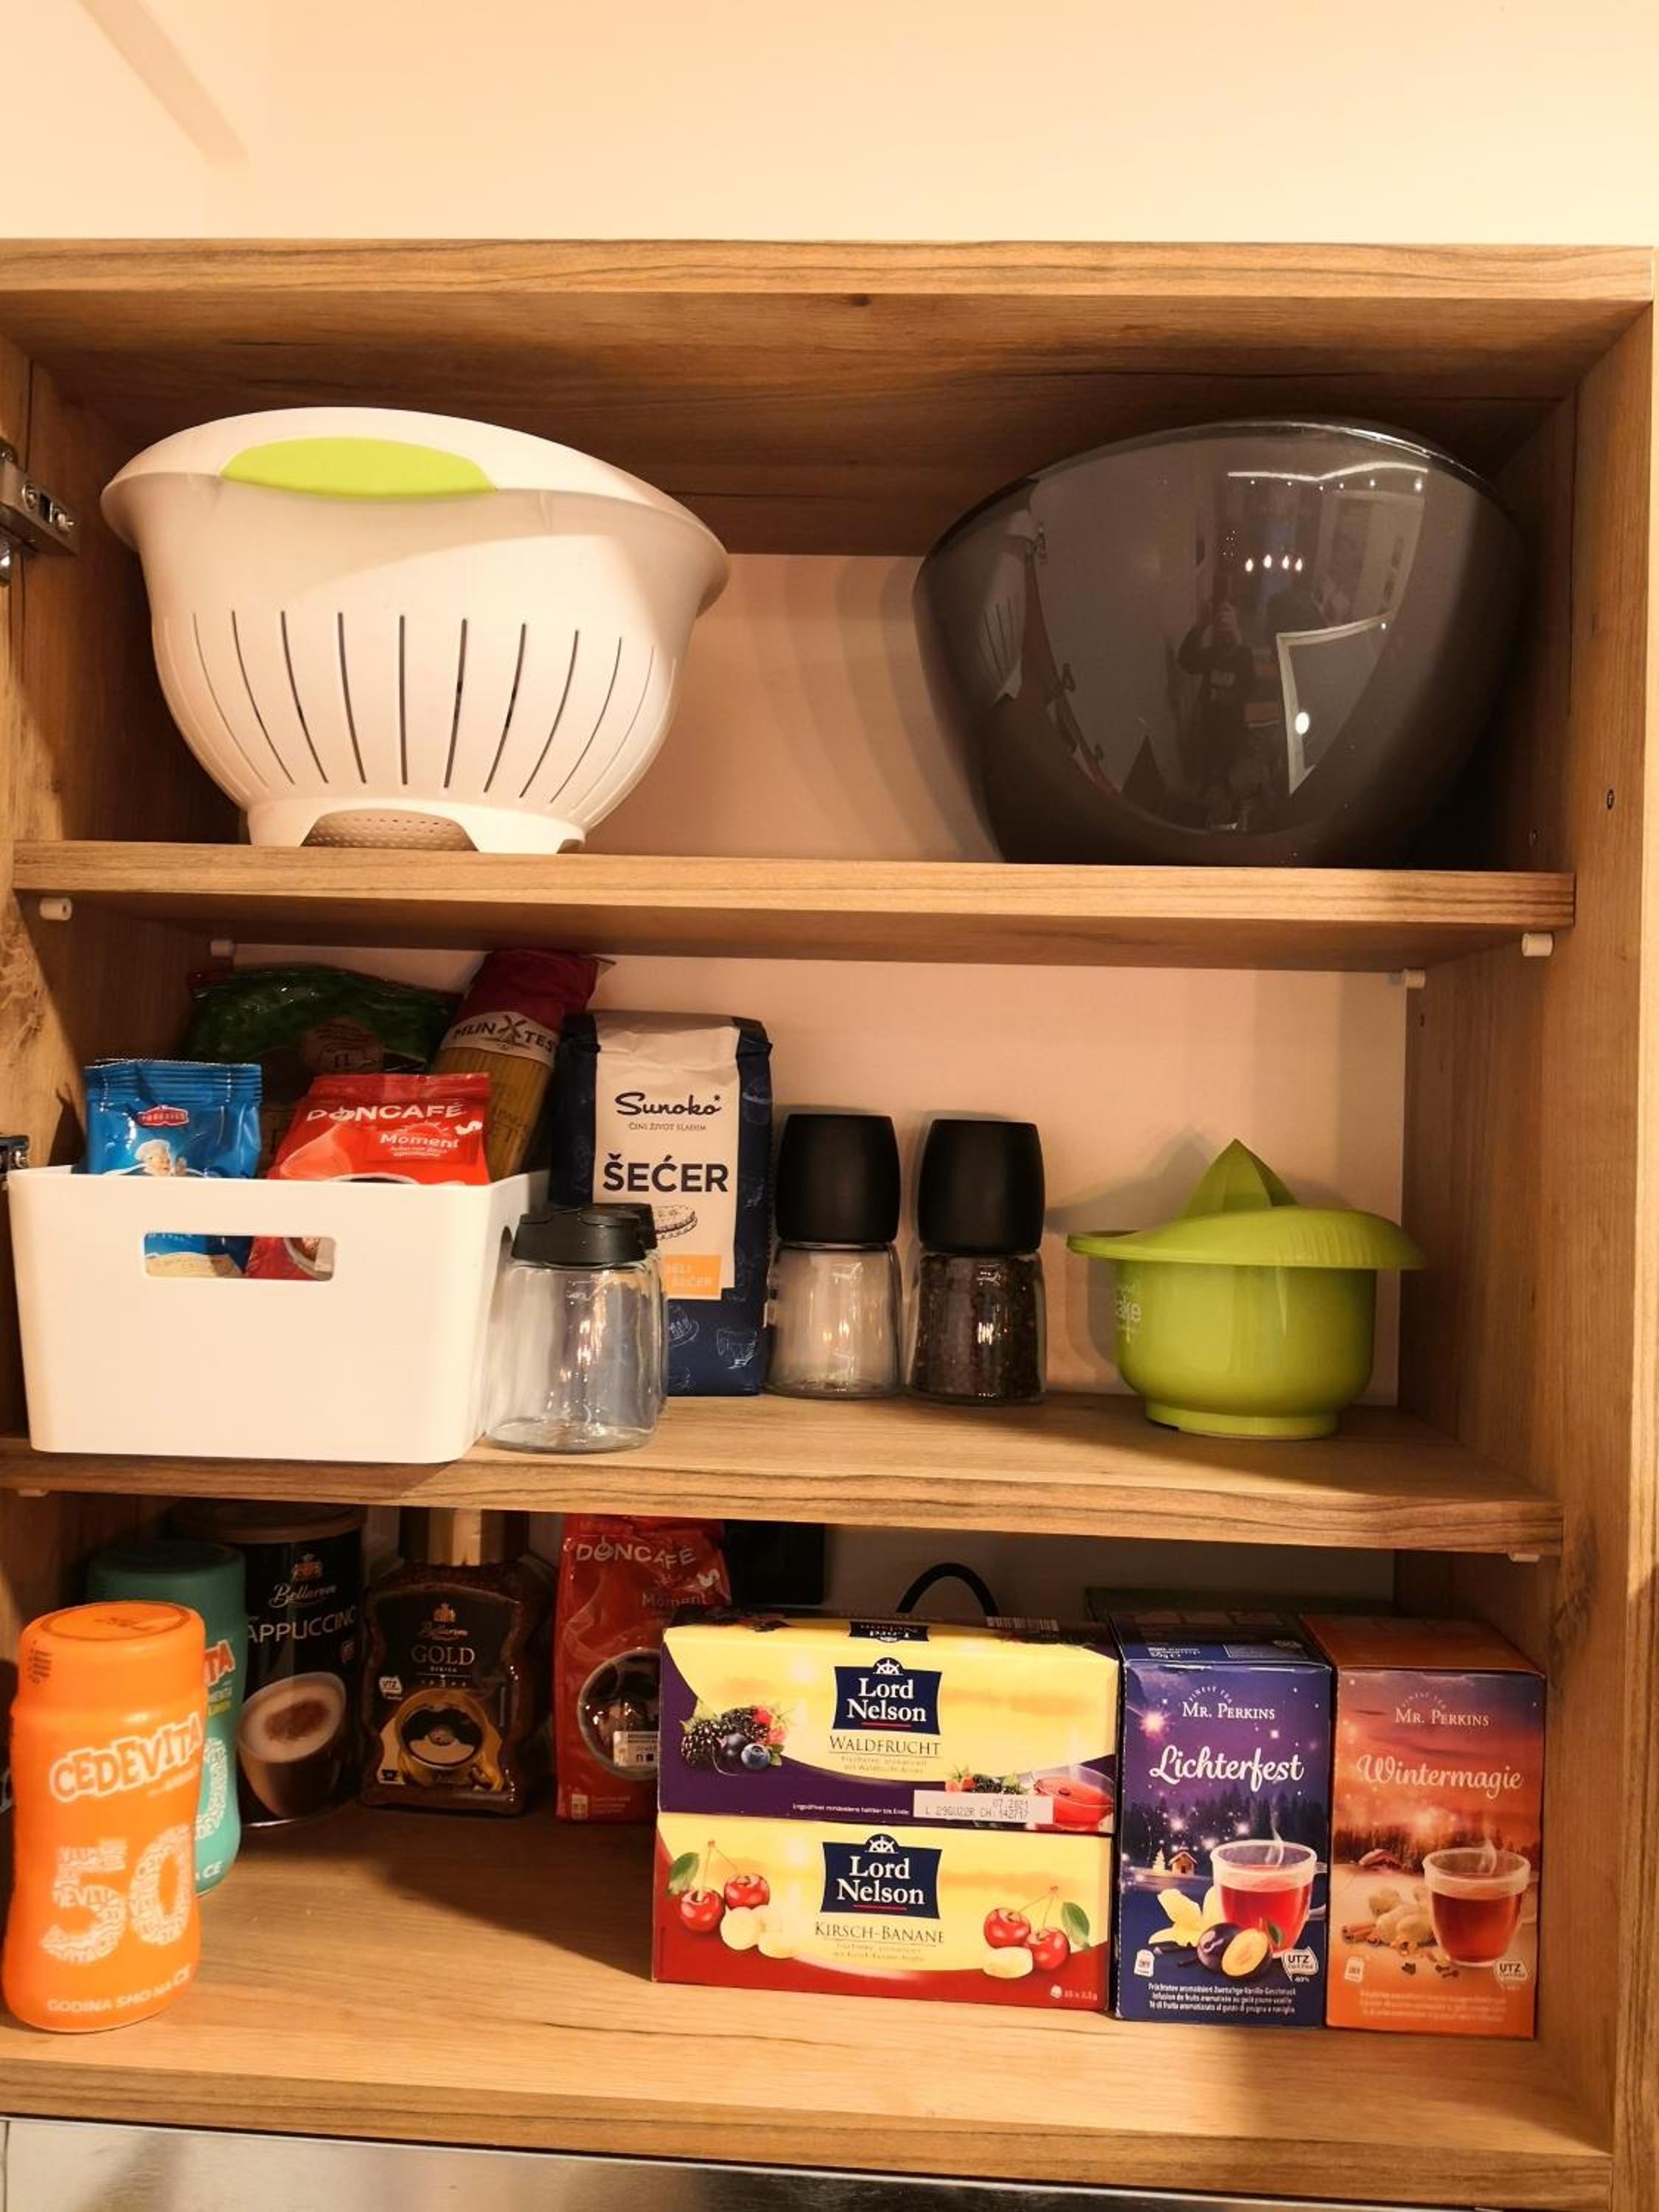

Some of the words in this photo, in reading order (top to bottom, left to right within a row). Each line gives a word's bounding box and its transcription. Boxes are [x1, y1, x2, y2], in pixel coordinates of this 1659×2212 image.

[615, 1092, 723, 1116] Sunoko
[380, 1133, 459, 1149] Moment
[602, 1152, 728, 1192] ŠEĆER
[412, 1644, 475, 1666] GOLD
[858, 1677, 914, 1700] Lord
[846, 1699, 927, 1722] Nelson
[1217, 1702, 1275, 1719] PERKINS
[1430, 1708, 1489, 1727] PERKINS
[49, 1711, 204, 1804] CEDEVITA
[830, 1736, 941, 1756] WALDFRUCHT
[1149, 1745, 1304, 1792] Lichterfest
[1356, 1754, 1522, 1799] Wintermagie
[849, 1855, 911, 1879] Lord
[39, 1824, 191, 1965] 50
[837, 1878, 925, 1905] Nelson
[815, 1921, 945, 1944] KIRSCH-BANANE
[1288, 1955, 1310, 1964] UTZ
[1499, 1963, 1521, 1972] UTZ
[47, 1998, 113, 2014] GODINA
